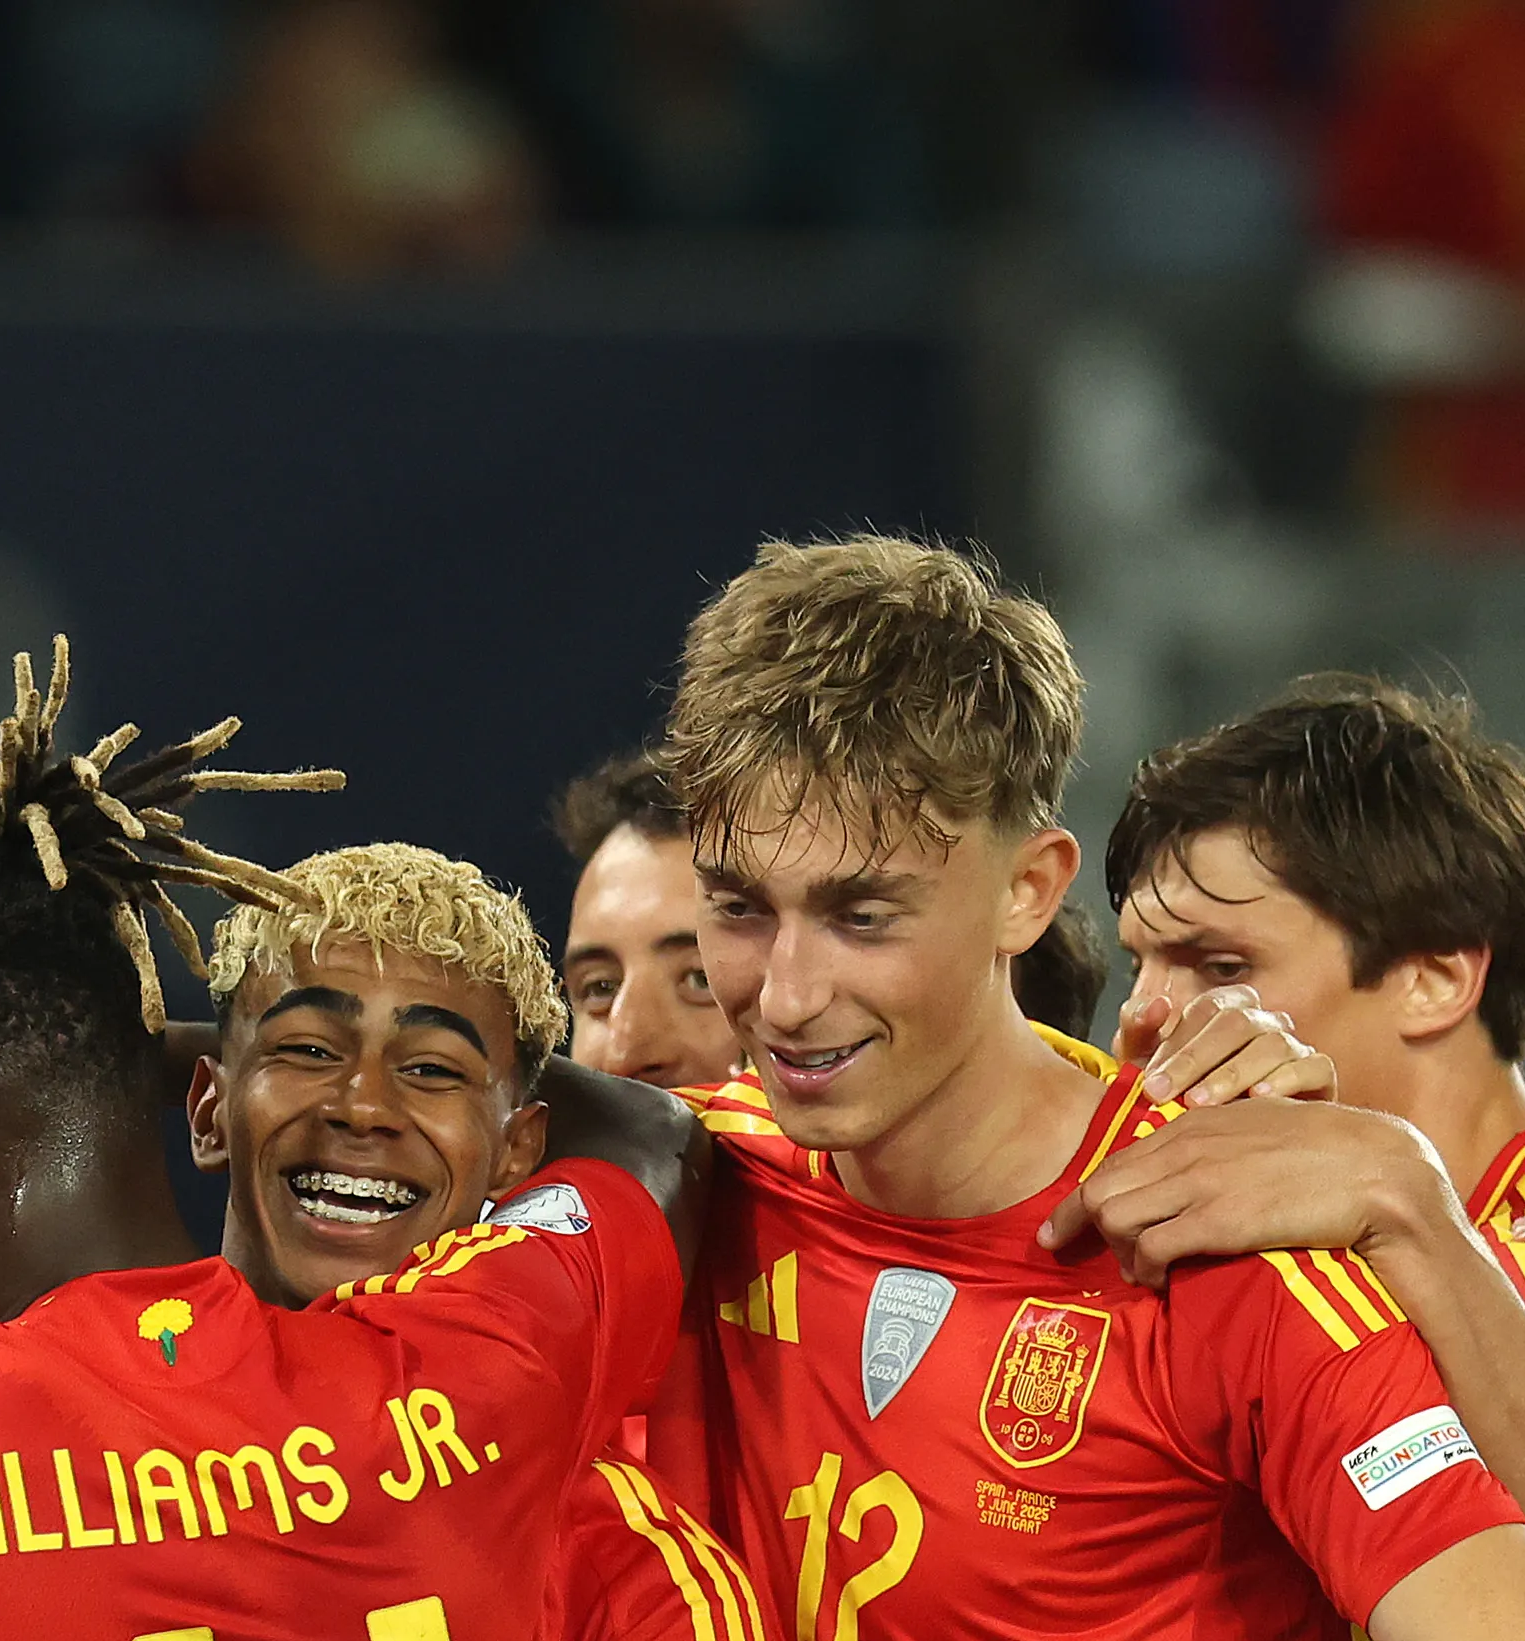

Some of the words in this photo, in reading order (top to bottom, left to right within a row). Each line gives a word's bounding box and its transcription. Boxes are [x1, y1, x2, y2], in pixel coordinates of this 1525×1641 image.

[879, 1284, 942, 1310] EUROPEAN
[875, 1298, 937, 1325] CHAMPIONS
[868, 1363, 902, 1382] 2024
[378, 1388, 502, 1502] JR.
[1348, 1445, 1379, 1470] UEFA
[975, 1479, 1007, 1498] SPAIN
[1015, 1488, 1057, 1510] FRANCE
[977, 1494, 986, 1509] 5
[988, 1497, 1018, 1515] JUNE
[1019, 1503, 1050, 1522] 2025
[979, 1509, 1042, 1535] STUTTGART
